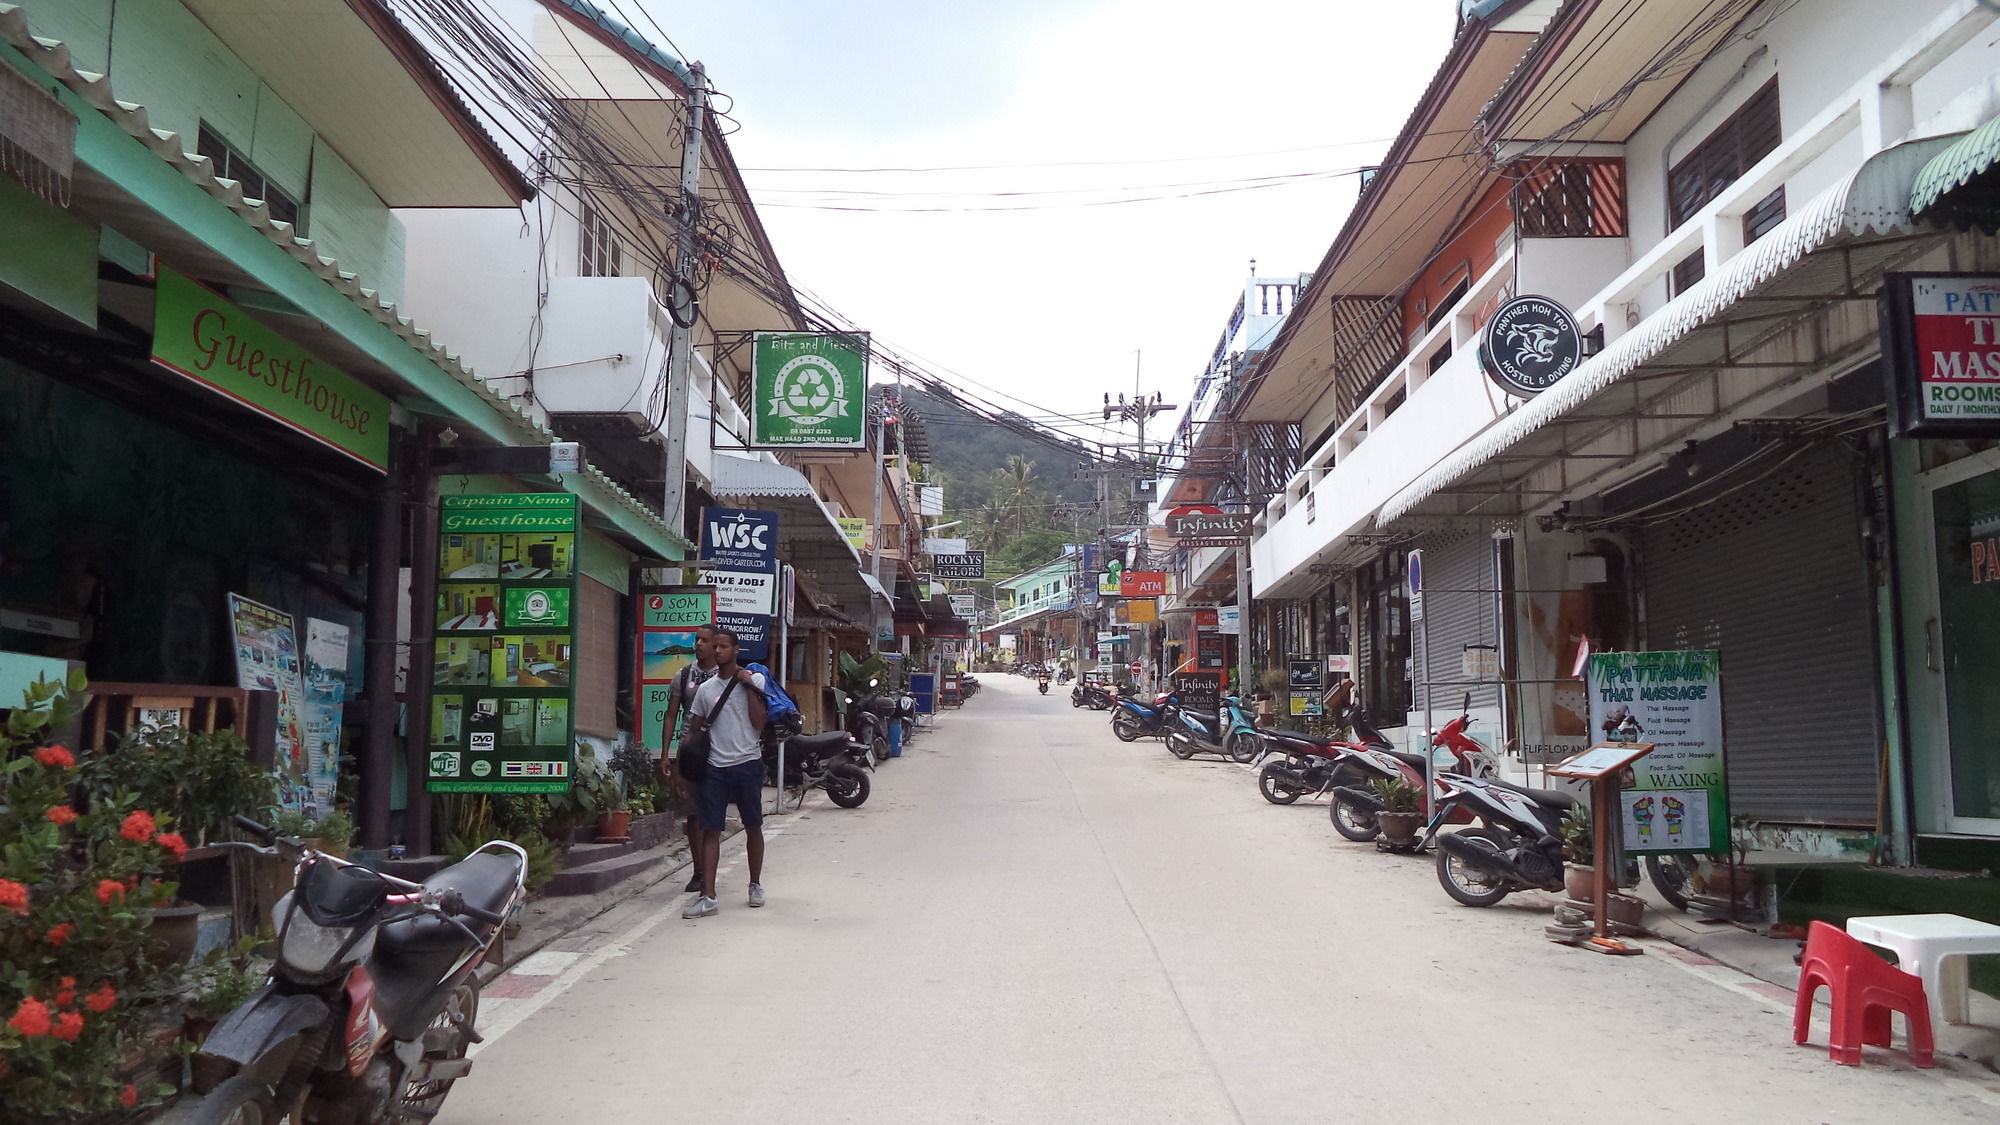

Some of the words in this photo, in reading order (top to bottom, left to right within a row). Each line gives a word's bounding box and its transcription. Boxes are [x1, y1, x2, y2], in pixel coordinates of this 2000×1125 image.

[1495, 304, 1529, 336] PANTHER
[1532, 304, 1551, 316] KOH
[1552, 312, 1569, 332] TAO
[771, 335, 796, 350] Bitz
[800, 337, 819, 350] and
[822, 336, 854, 350] Piec
[1501, 359, 1535, 386] HOSTEL
[1538, 376, 1545, 385] &
[1547, 355, 1573, 382] DIVING
[1931, 351, 2000, 379] MAS
[193, 309, 371, 436] Guesthouse
[1930, 404, 1953, 414] DAILY
[445, 496, 513, 508] Captain
[518, 496, 570, 505] Nemo
[446, 514, 573, 529] Guesthouse
[1175, 517, 1249, 535] Infinity
[709, 521, 769, 551] WSC
[937, 555, 982, 565] ROCKYS
[937, 567, 982, 577] TAILORS
[706, 575, 735, 585] DIVE
[738, 577, 765, 587] JOBS
[1139, 582, 1162, 591] ATM
[668, 597, 699, 609] SOM
[655, 611, 708, 622] TICKETS
[716, 616, 730, 624] OIN
[731, 617, 754, 625] NOW!
[722, 624, 762, 633] TOMORROW!
[1466, 652, 1497, 662] Sale
[1467, 664, 1495, 673] 100
[1606, 663, 1703, 684] PATTAMA
[1179, 678, 1218, 694] Infinity
[1184, 695, 1214, 703] ROOMS
[1600, 687, 1634, 703] THAI
[1641, 685, 1708, 702] MASSAGE
[1663, 705, 1689, 713] Massage
[1665, 717, 1691, 725] Massage
[1659, 729, 1686, 737] Massage
[472, 735, 493, 743] DVD
[1689, 752, 1715, 760] Massage
[1649, 773, 1719, 787] WAXING
